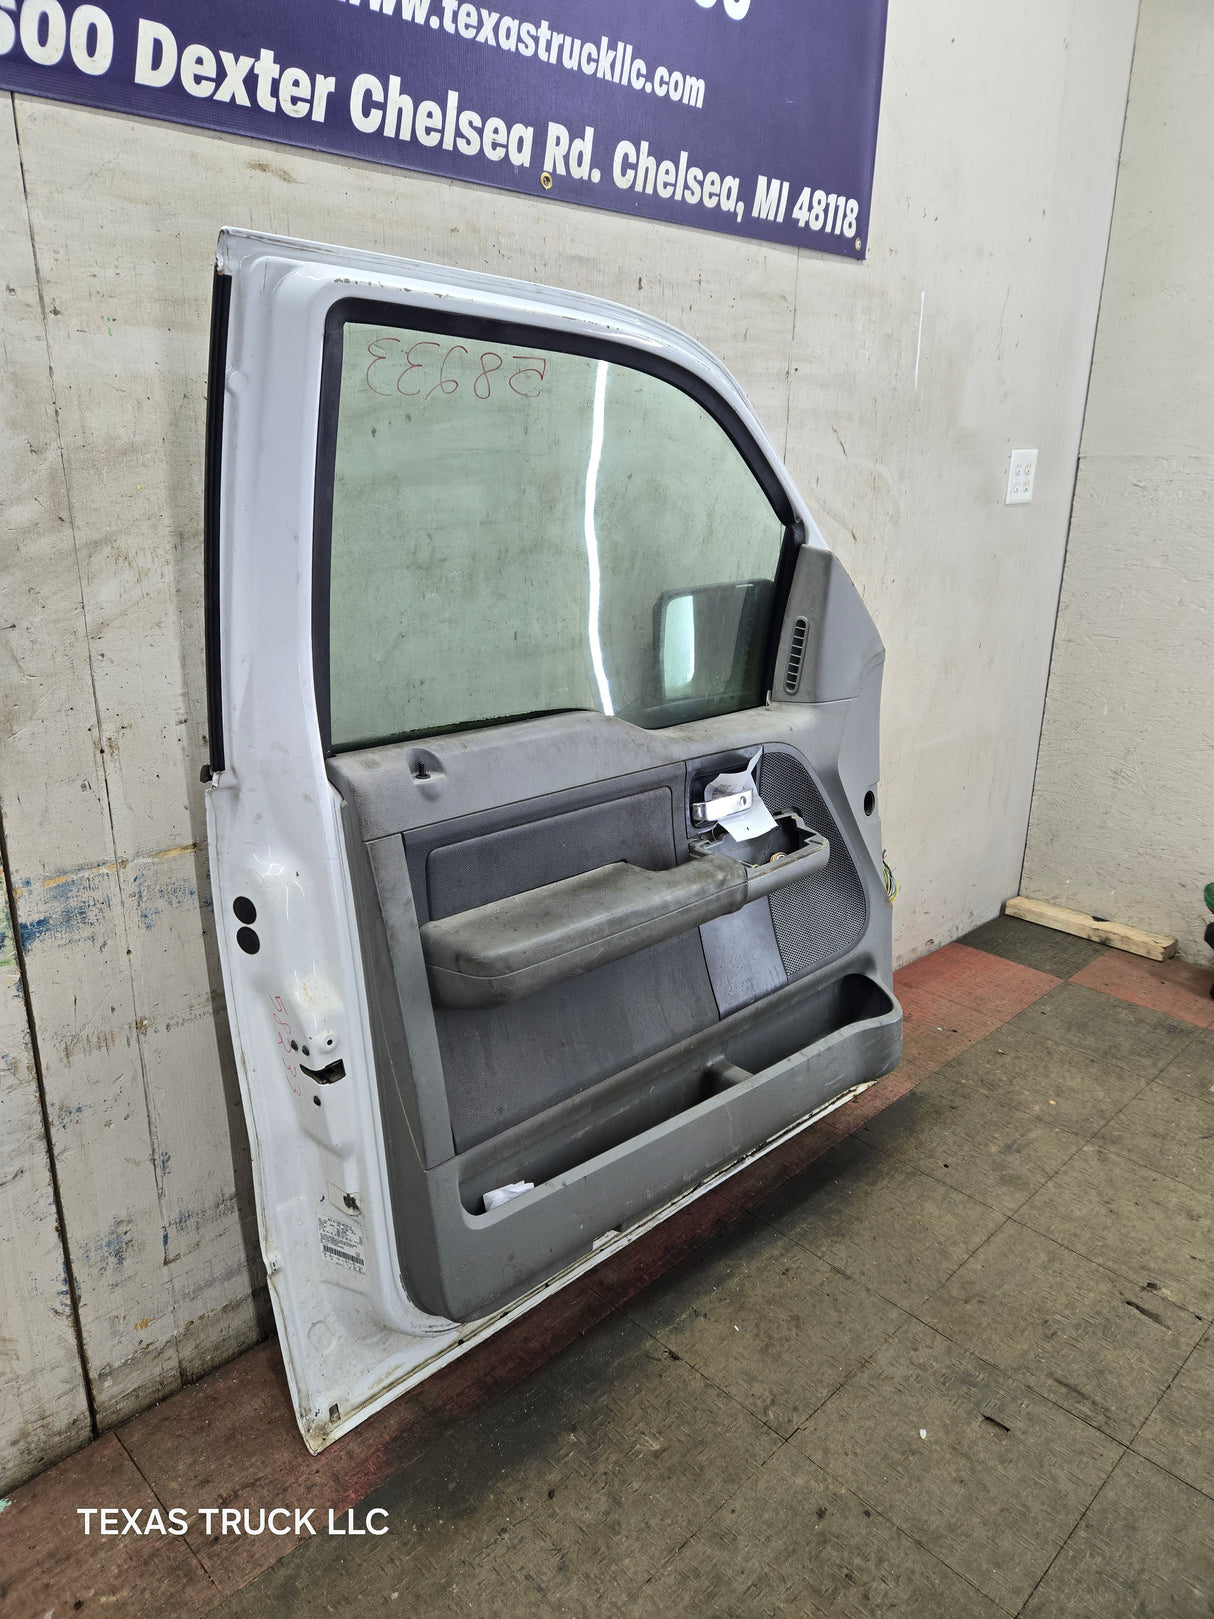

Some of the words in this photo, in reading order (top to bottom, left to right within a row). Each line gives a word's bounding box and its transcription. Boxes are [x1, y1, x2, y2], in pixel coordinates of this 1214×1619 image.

[134, 18, 337, 123] Dexter
[349, 74, 535, 168] Chelsea
[543, 121, 602, 184] Rd.
[612, 139, 745, 223] Chelsea,
[751, 175, 790, 224] MI
[791, 186, 860, 239] 48118
